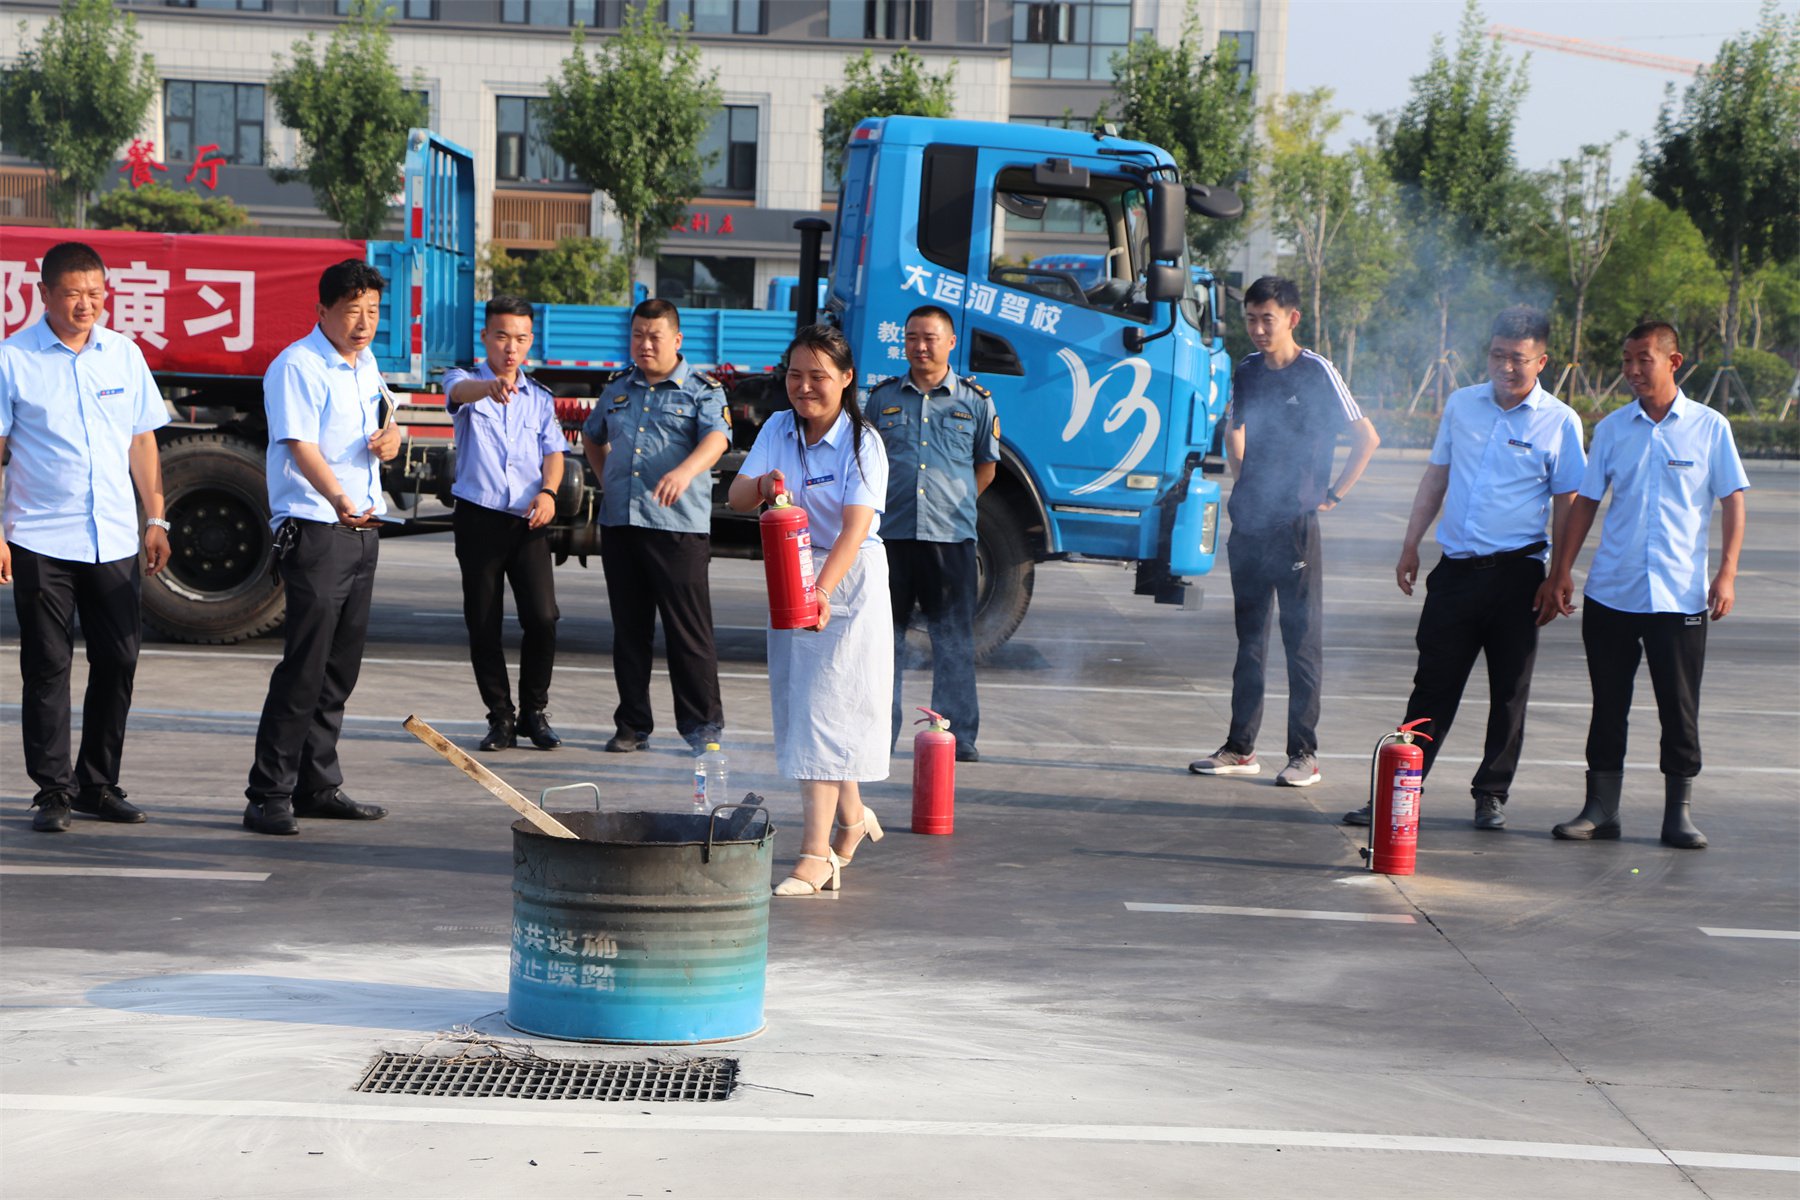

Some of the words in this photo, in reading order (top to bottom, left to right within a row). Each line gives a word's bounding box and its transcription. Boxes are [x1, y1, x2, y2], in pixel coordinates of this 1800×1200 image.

[120, 139, 226, 190] 餐厅
[901, 265, 1062, 335] 大运河驾校
[877, 320, 906, 344] 教
